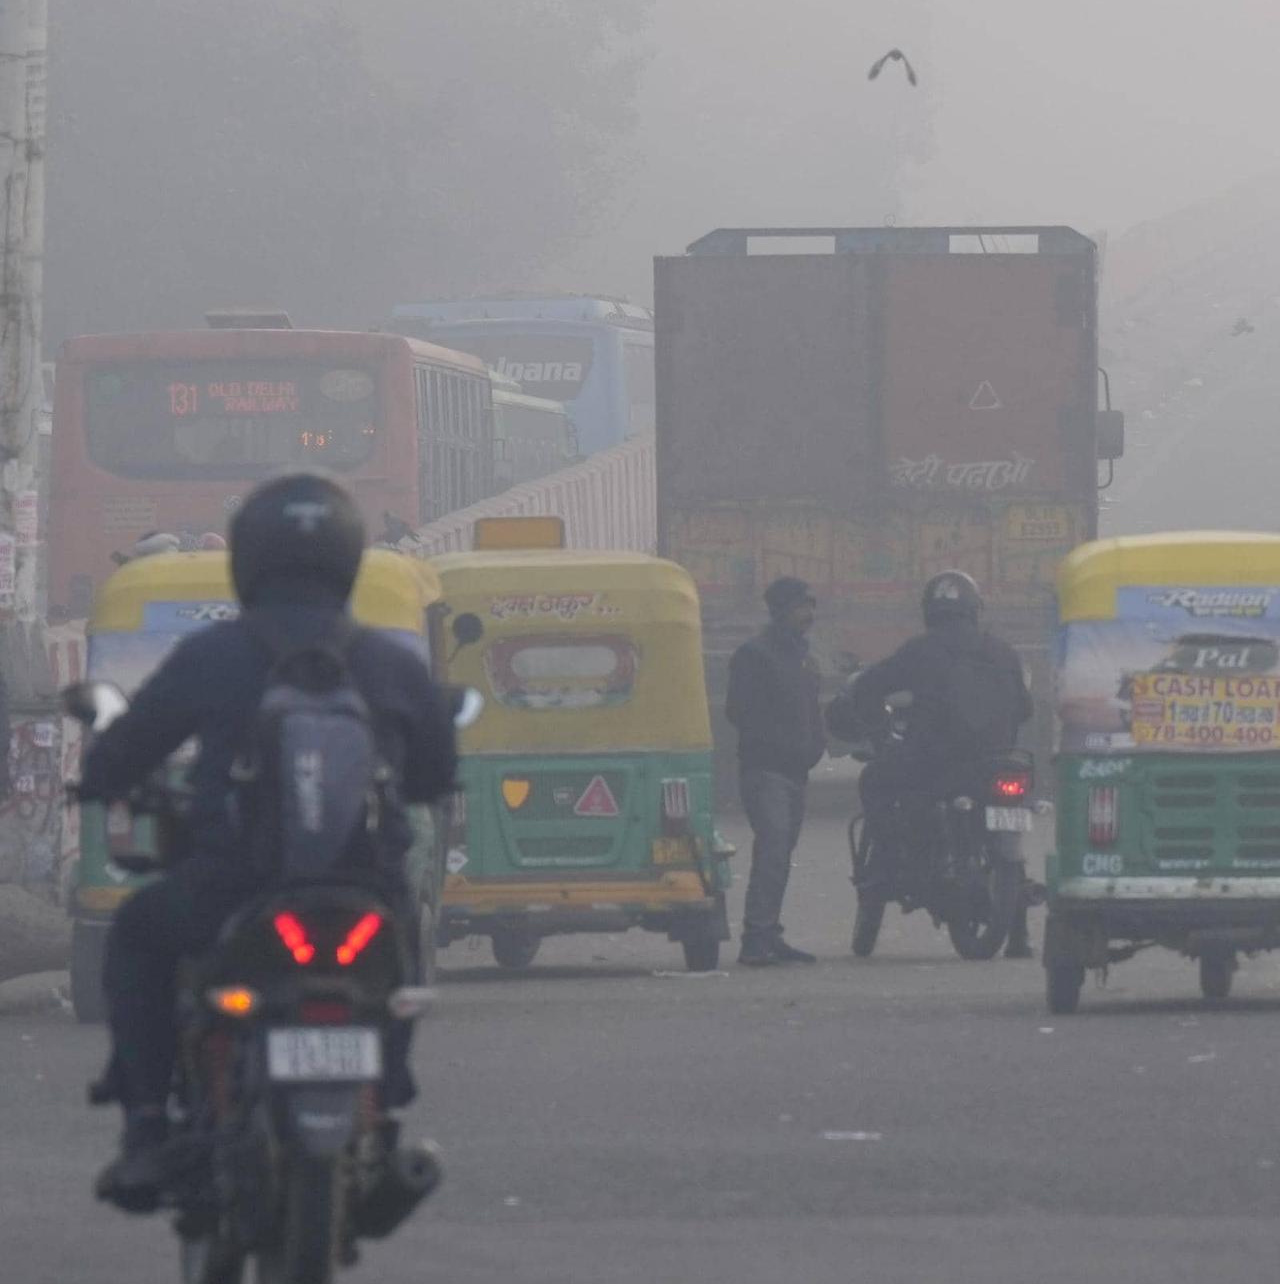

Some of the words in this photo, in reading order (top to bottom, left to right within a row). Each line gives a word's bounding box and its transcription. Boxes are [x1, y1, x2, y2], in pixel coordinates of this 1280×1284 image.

[168, 381, 198, 415] 131
[1194, 647, 1249, 668] Pal
[1153, 677, 1215, 697] CASH
[1083, 853, 1124, 876] CNG
